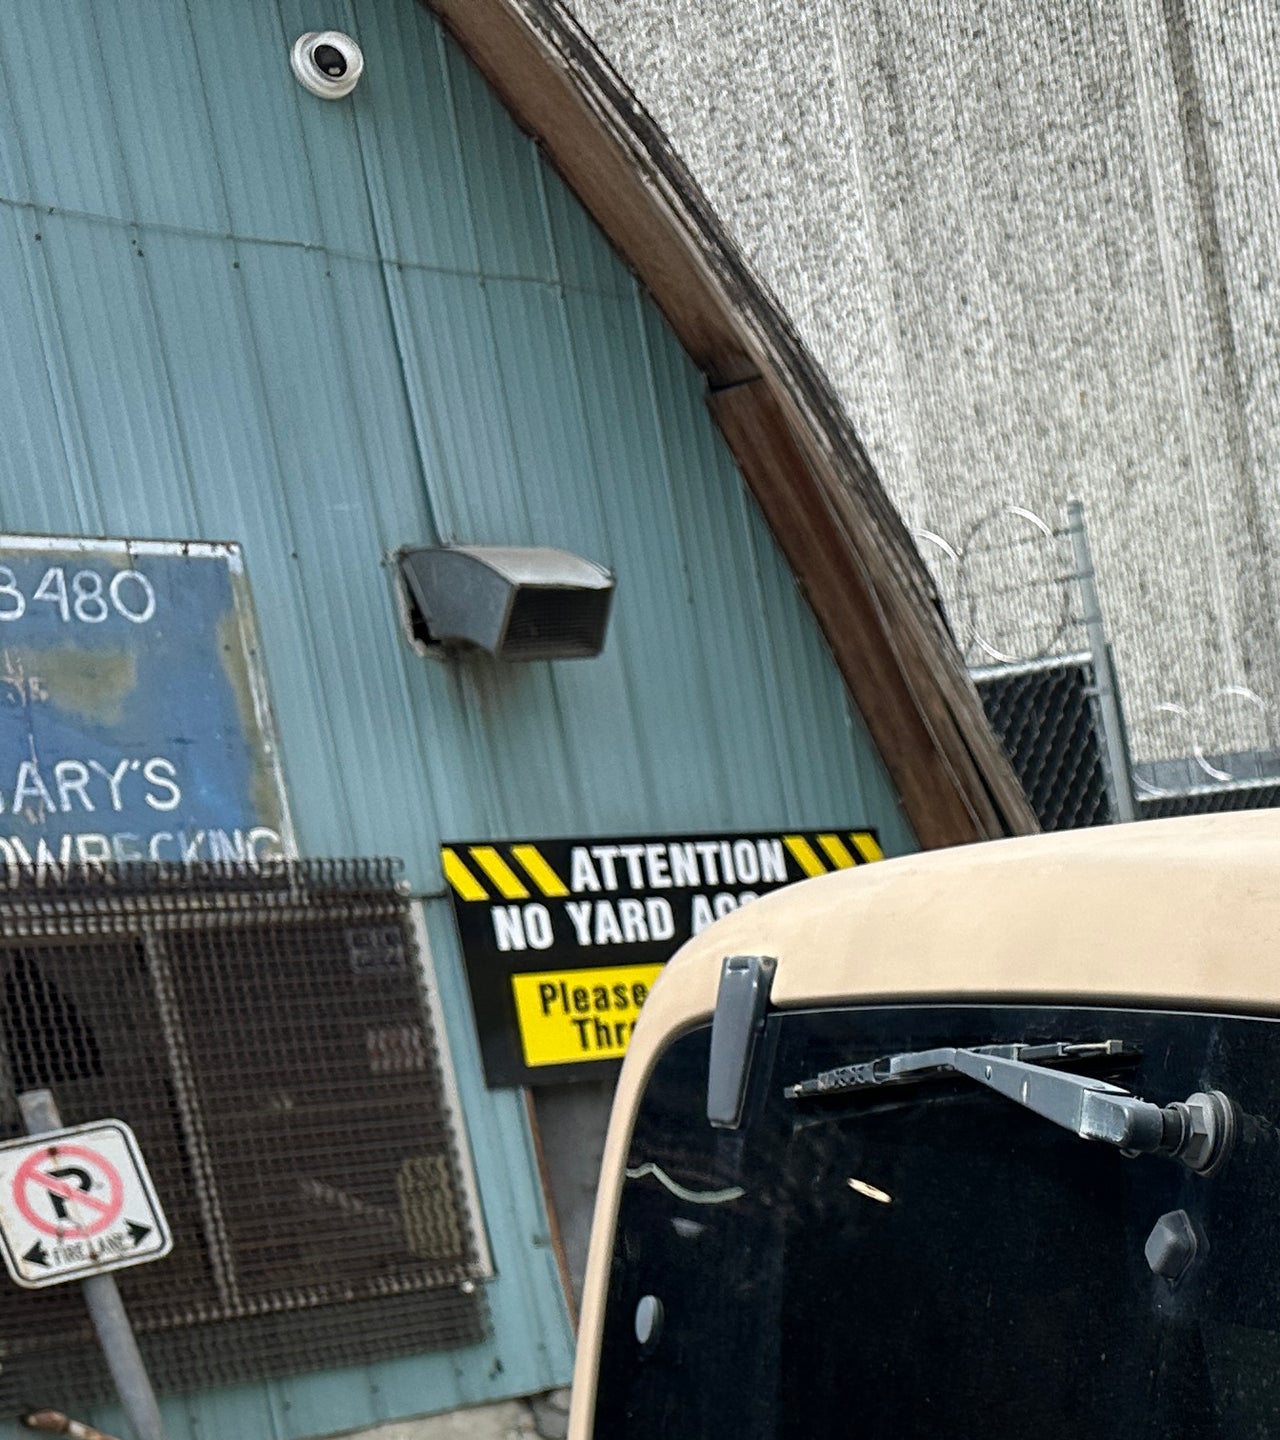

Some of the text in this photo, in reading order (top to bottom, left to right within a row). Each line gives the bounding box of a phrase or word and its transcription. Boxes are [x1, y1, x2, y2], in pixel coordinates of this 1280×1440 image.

[0, 756, 182, 814] ARY'S
[570, 838, 789, 893] ATTENTION
[490, 903, 555, 951] NO
[564, 896, 676, 946] YARD
[539, 980, 650, 1016] Please
[571, 1017, 637, 1051] Thr
